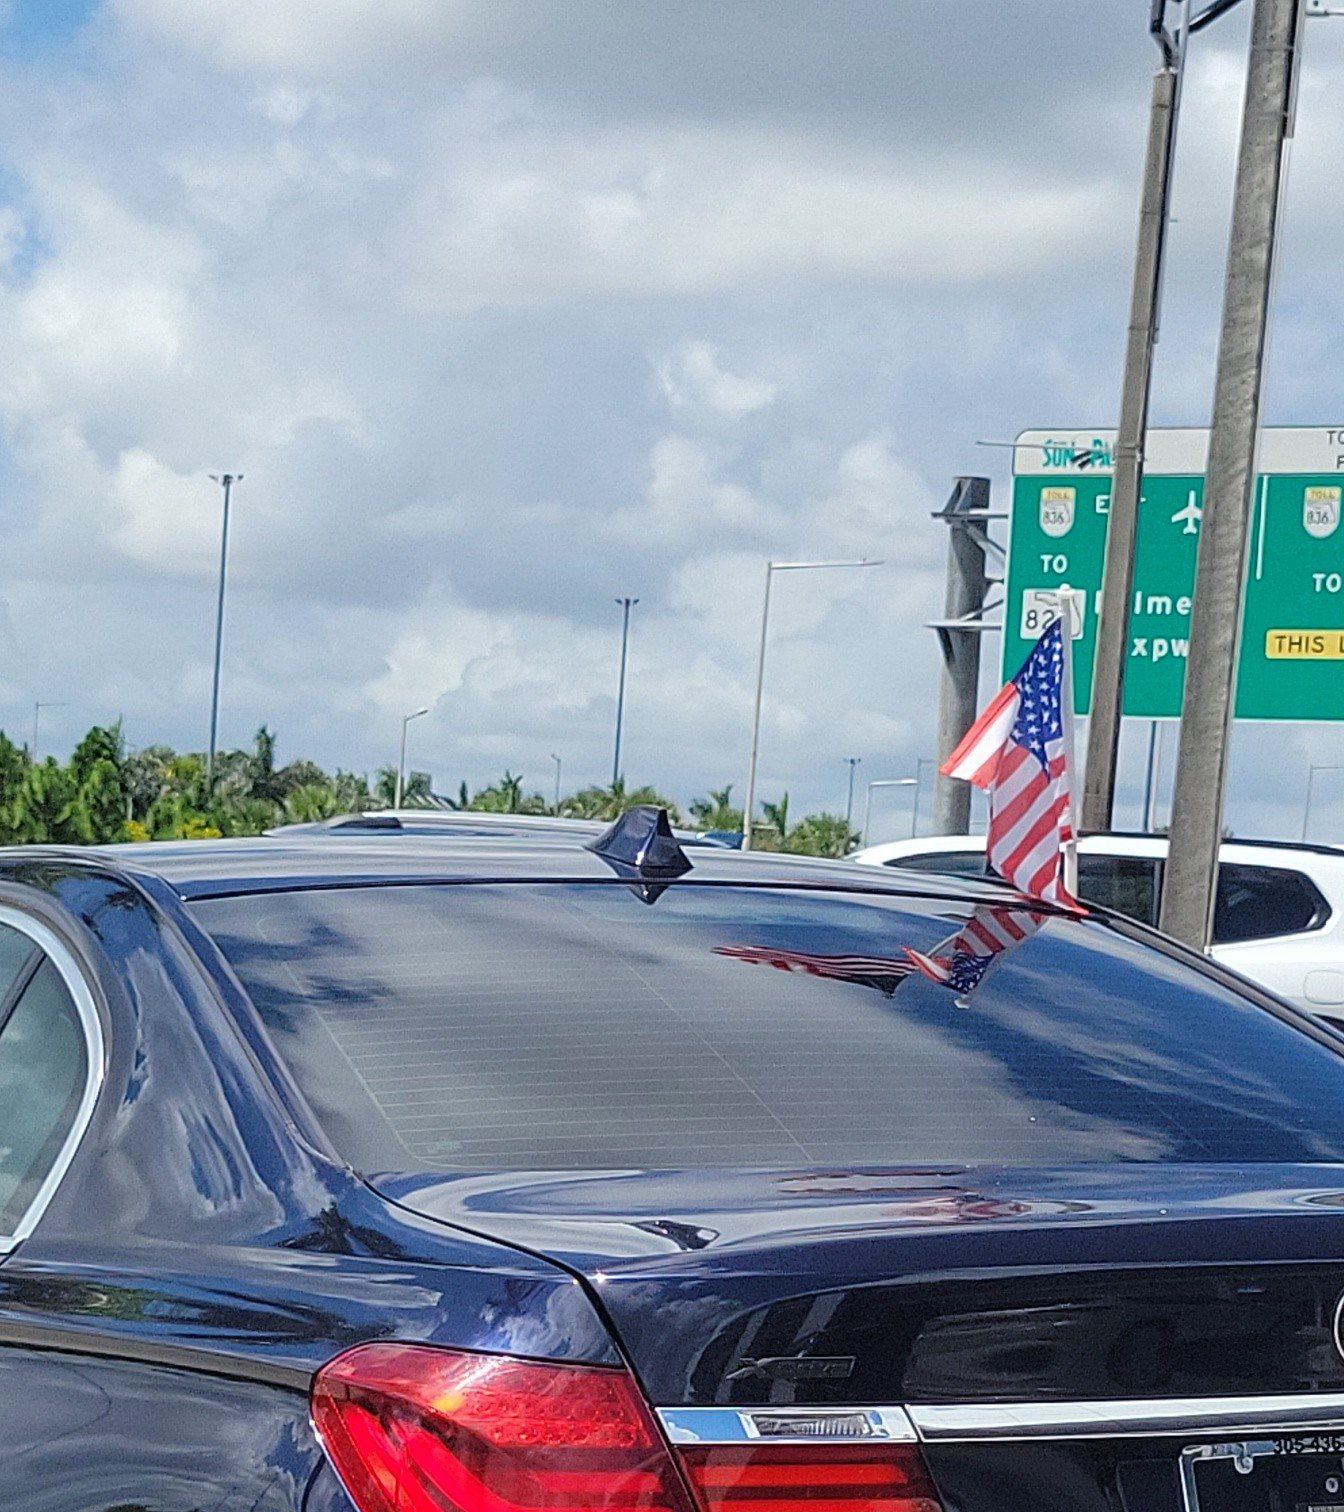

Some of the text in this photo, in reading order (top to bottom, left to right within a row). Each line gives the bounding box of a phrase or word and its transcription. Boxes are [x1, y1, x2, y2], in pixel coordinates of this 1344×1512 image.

[1040, 554, 1068, 574] TO
[1312, 572, 1343, 593] TO
[1275, 634, 1325, 654] THIS
